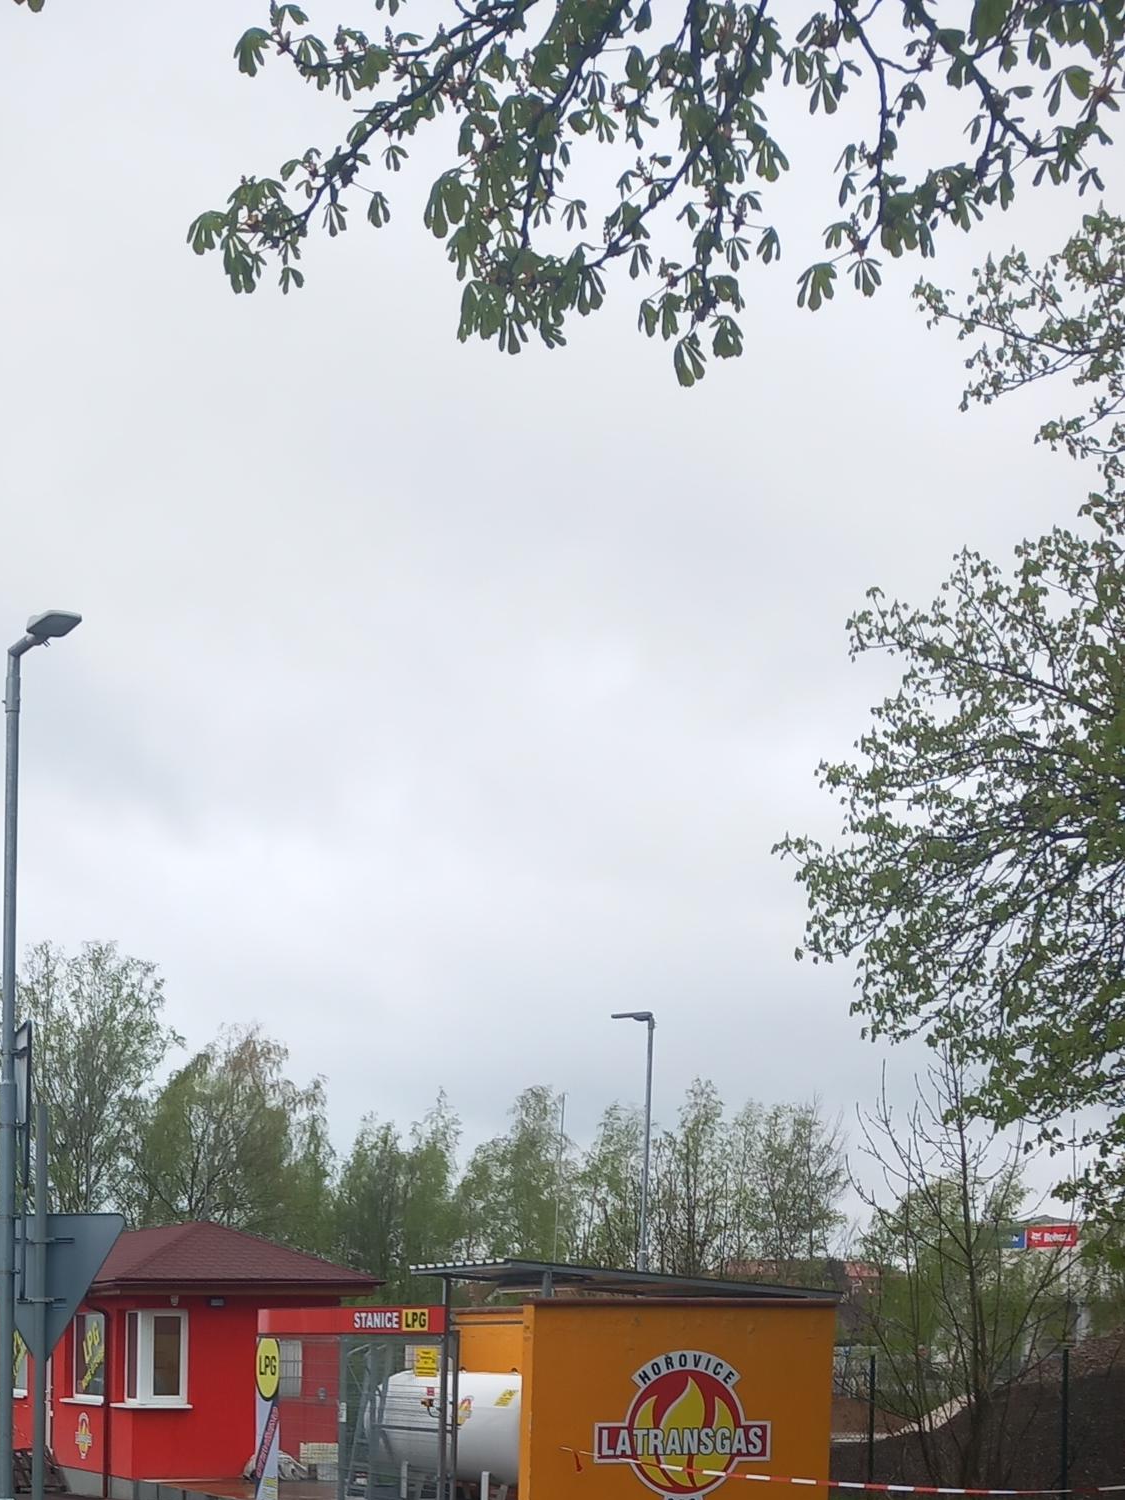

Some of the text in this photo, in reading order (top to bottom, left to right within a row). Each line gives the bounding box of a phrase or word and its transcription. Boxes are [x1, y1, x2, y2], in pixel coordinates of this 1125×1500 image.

[353, 1311, 427, 1329] STANICE LPG
[259, 1355, 277, 1376] LPG
[638, 1352, 736, 1385] HOŘOVICE
[601, 1426, 763, 1456] LATRANSGAS
